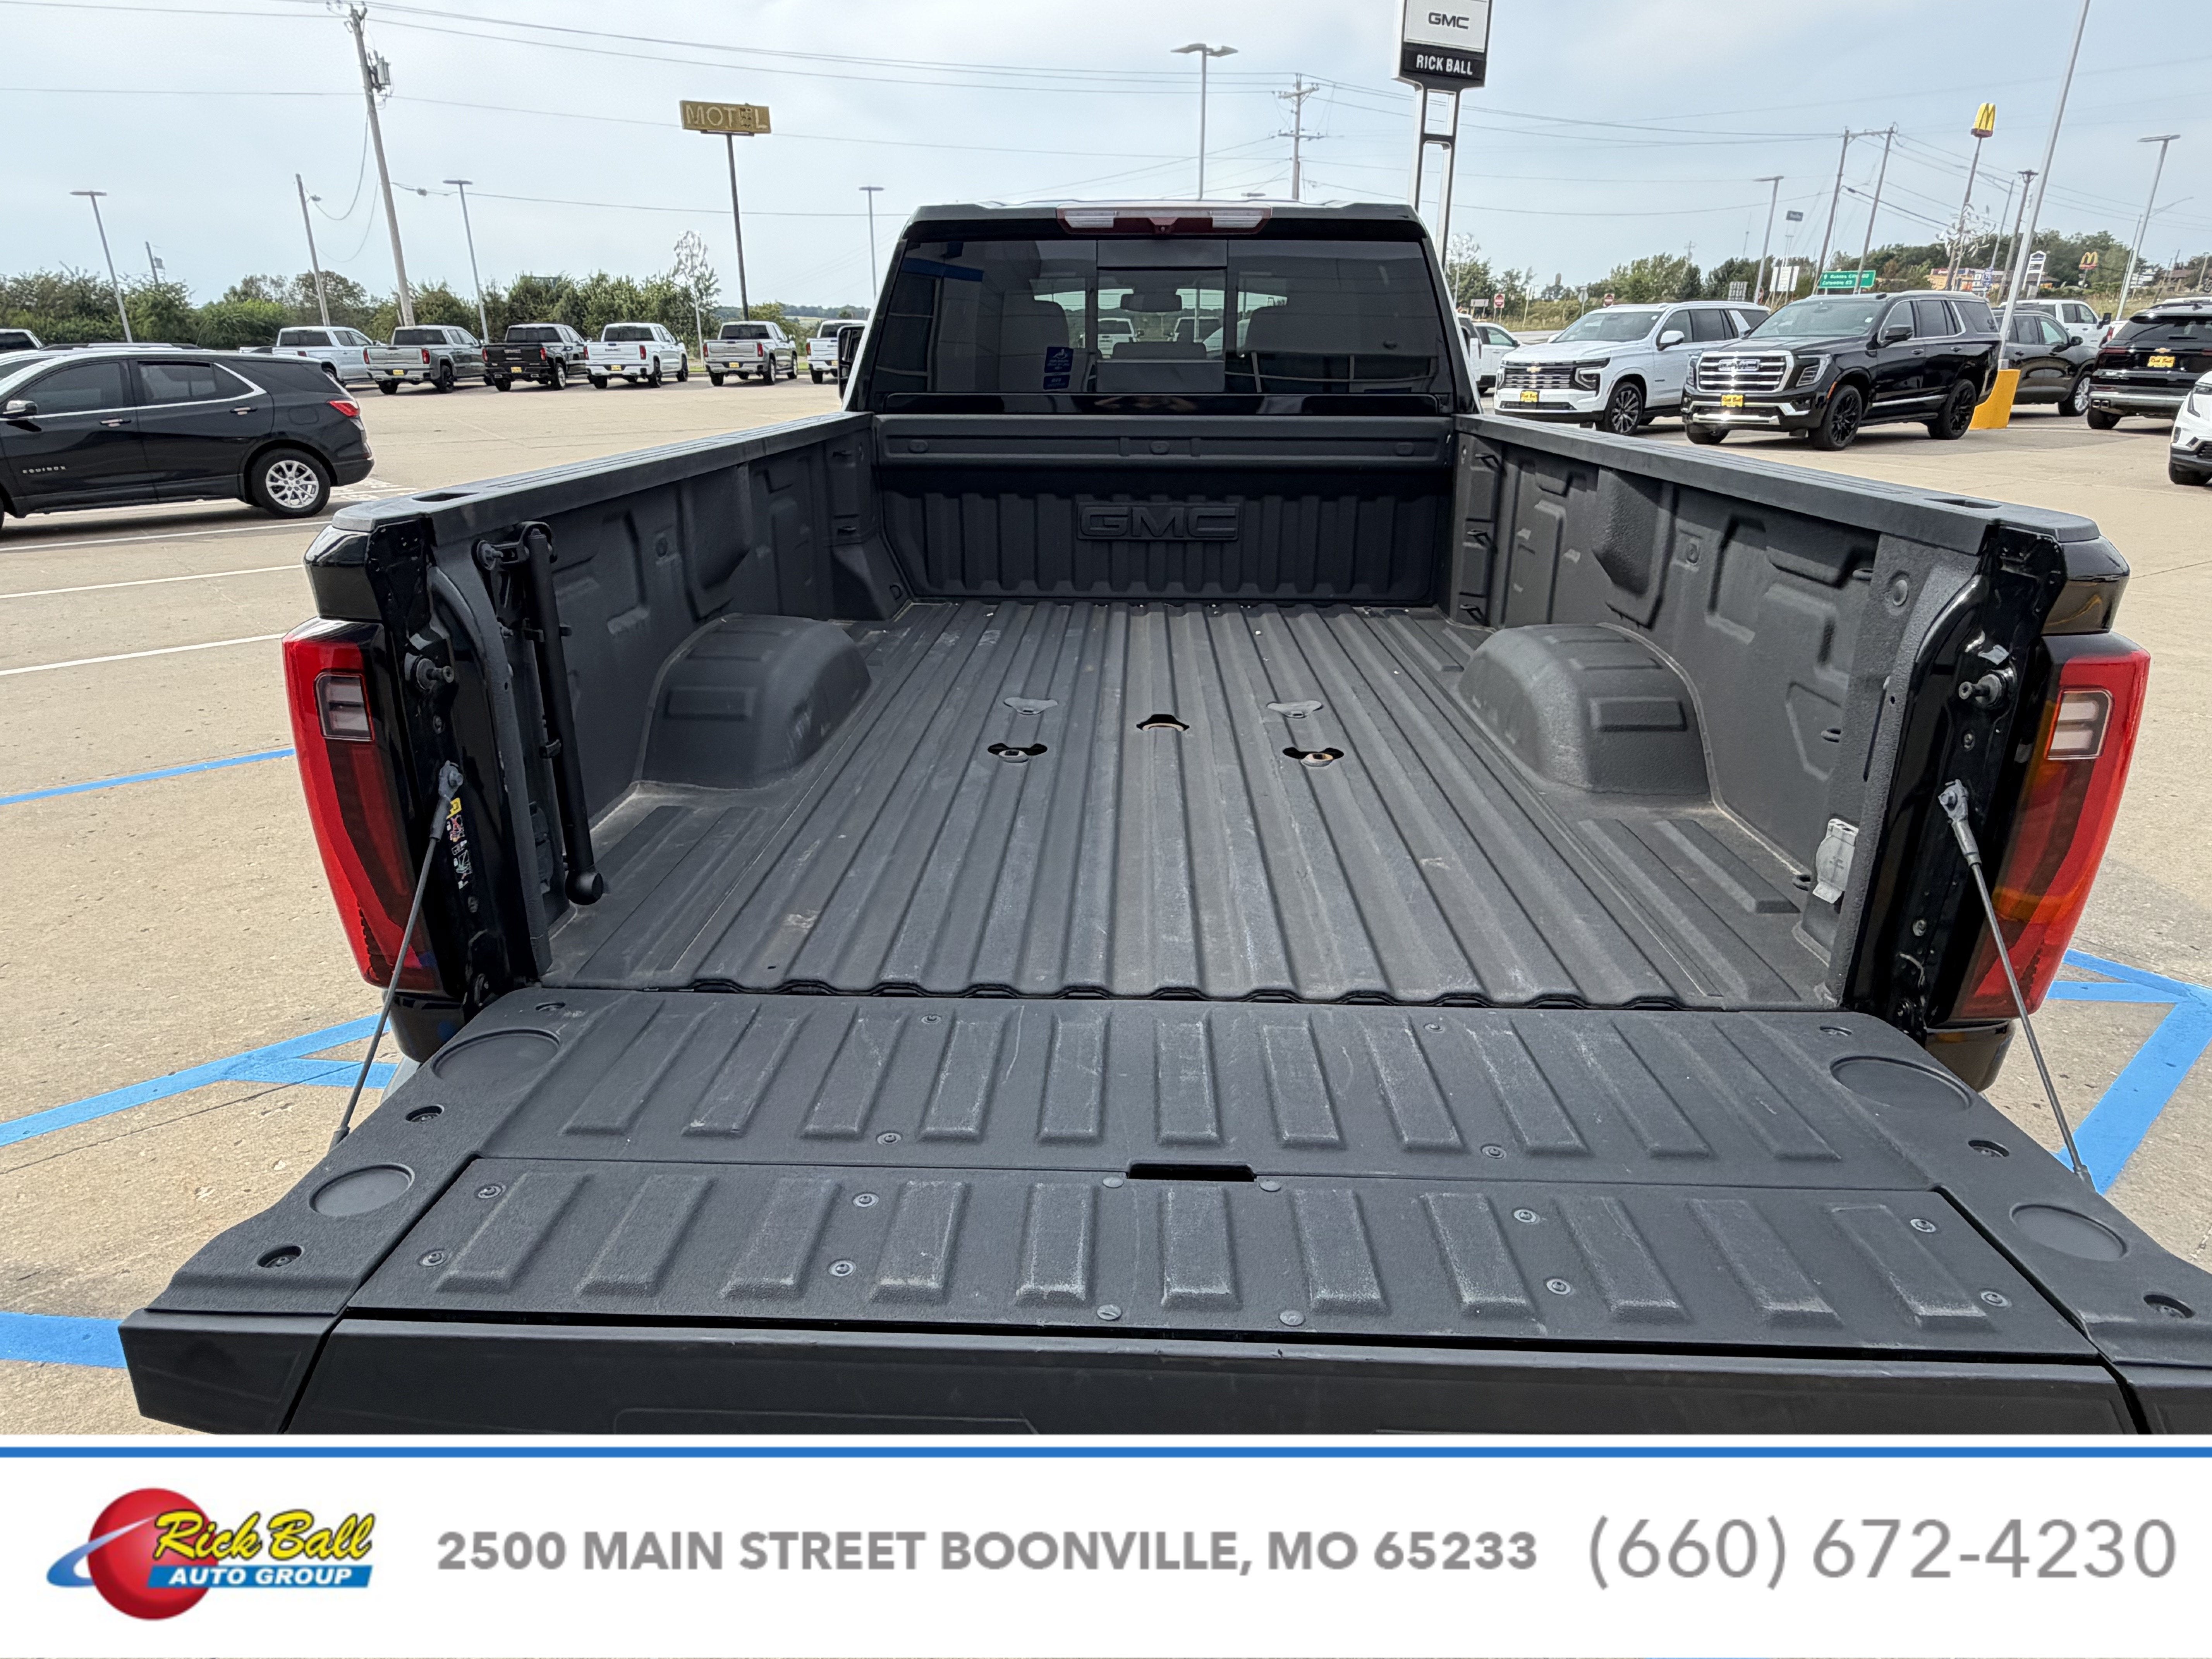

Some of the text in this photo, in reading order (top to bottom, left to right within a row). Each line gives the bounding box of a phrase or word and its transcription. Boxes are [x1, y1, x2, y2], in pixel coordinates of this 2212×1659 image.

[1428, 12, 1469, 29] GMC
[1416, 54, 1473, 75] RICK BALL
[685, 105, 768, 129] MOTEL
[1080, 506, 1236, 539] GMC
